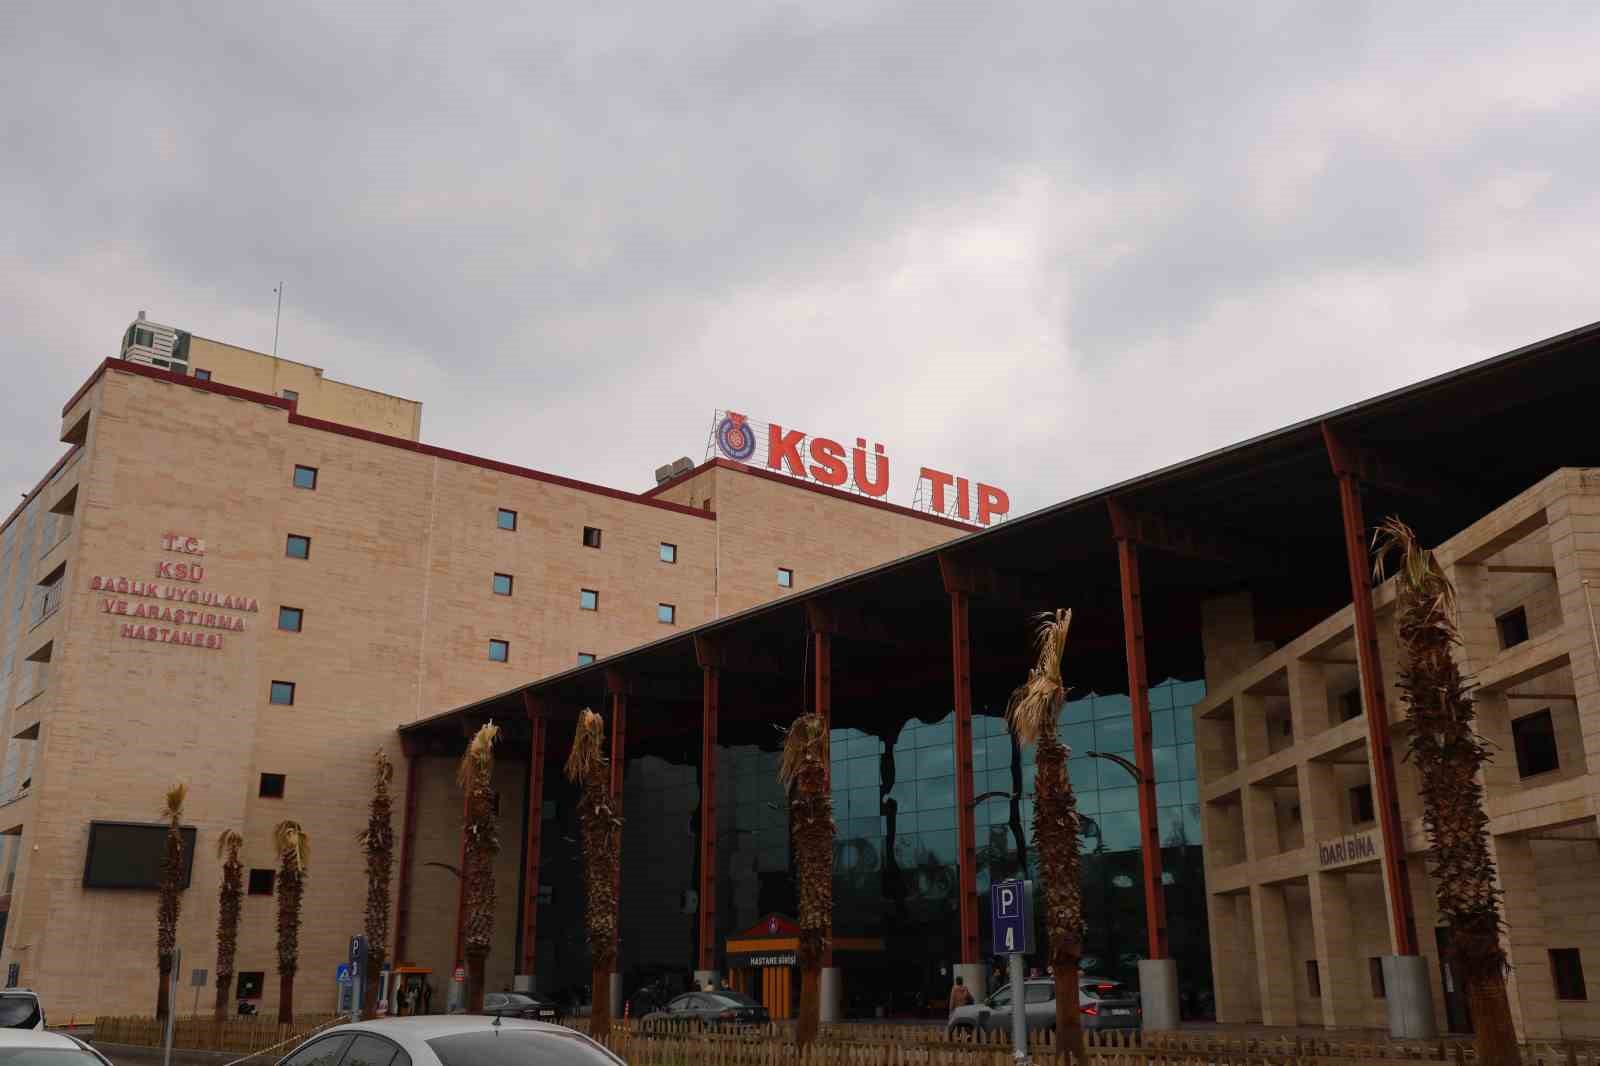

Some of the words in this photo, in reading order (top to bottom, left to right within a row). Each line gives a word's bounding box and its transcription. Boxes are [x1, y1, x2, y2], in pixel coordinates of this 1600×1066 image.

[768, 423, 889, 497] KSÜ
[920, 466, 1010, 525] TIP
[162, 533, 207, 556] T.C.
[158, 560, 205, 582] KSÜ
[90, 575, 158, 598] SAĞLIK
[165, 586, 258, 612] UYGULAMA
[103, 598, 129, 614] VE
[134, 603, 245, 631] ARAŞTIRMA
[121, 623, 224, 649] HASTANESİ
[1001, 888, 1014, 915] P
[352, 938, 359, 953] P
[1005, 927, 1014, 951] 4
[750, 955, 776, 966] HASTANE
